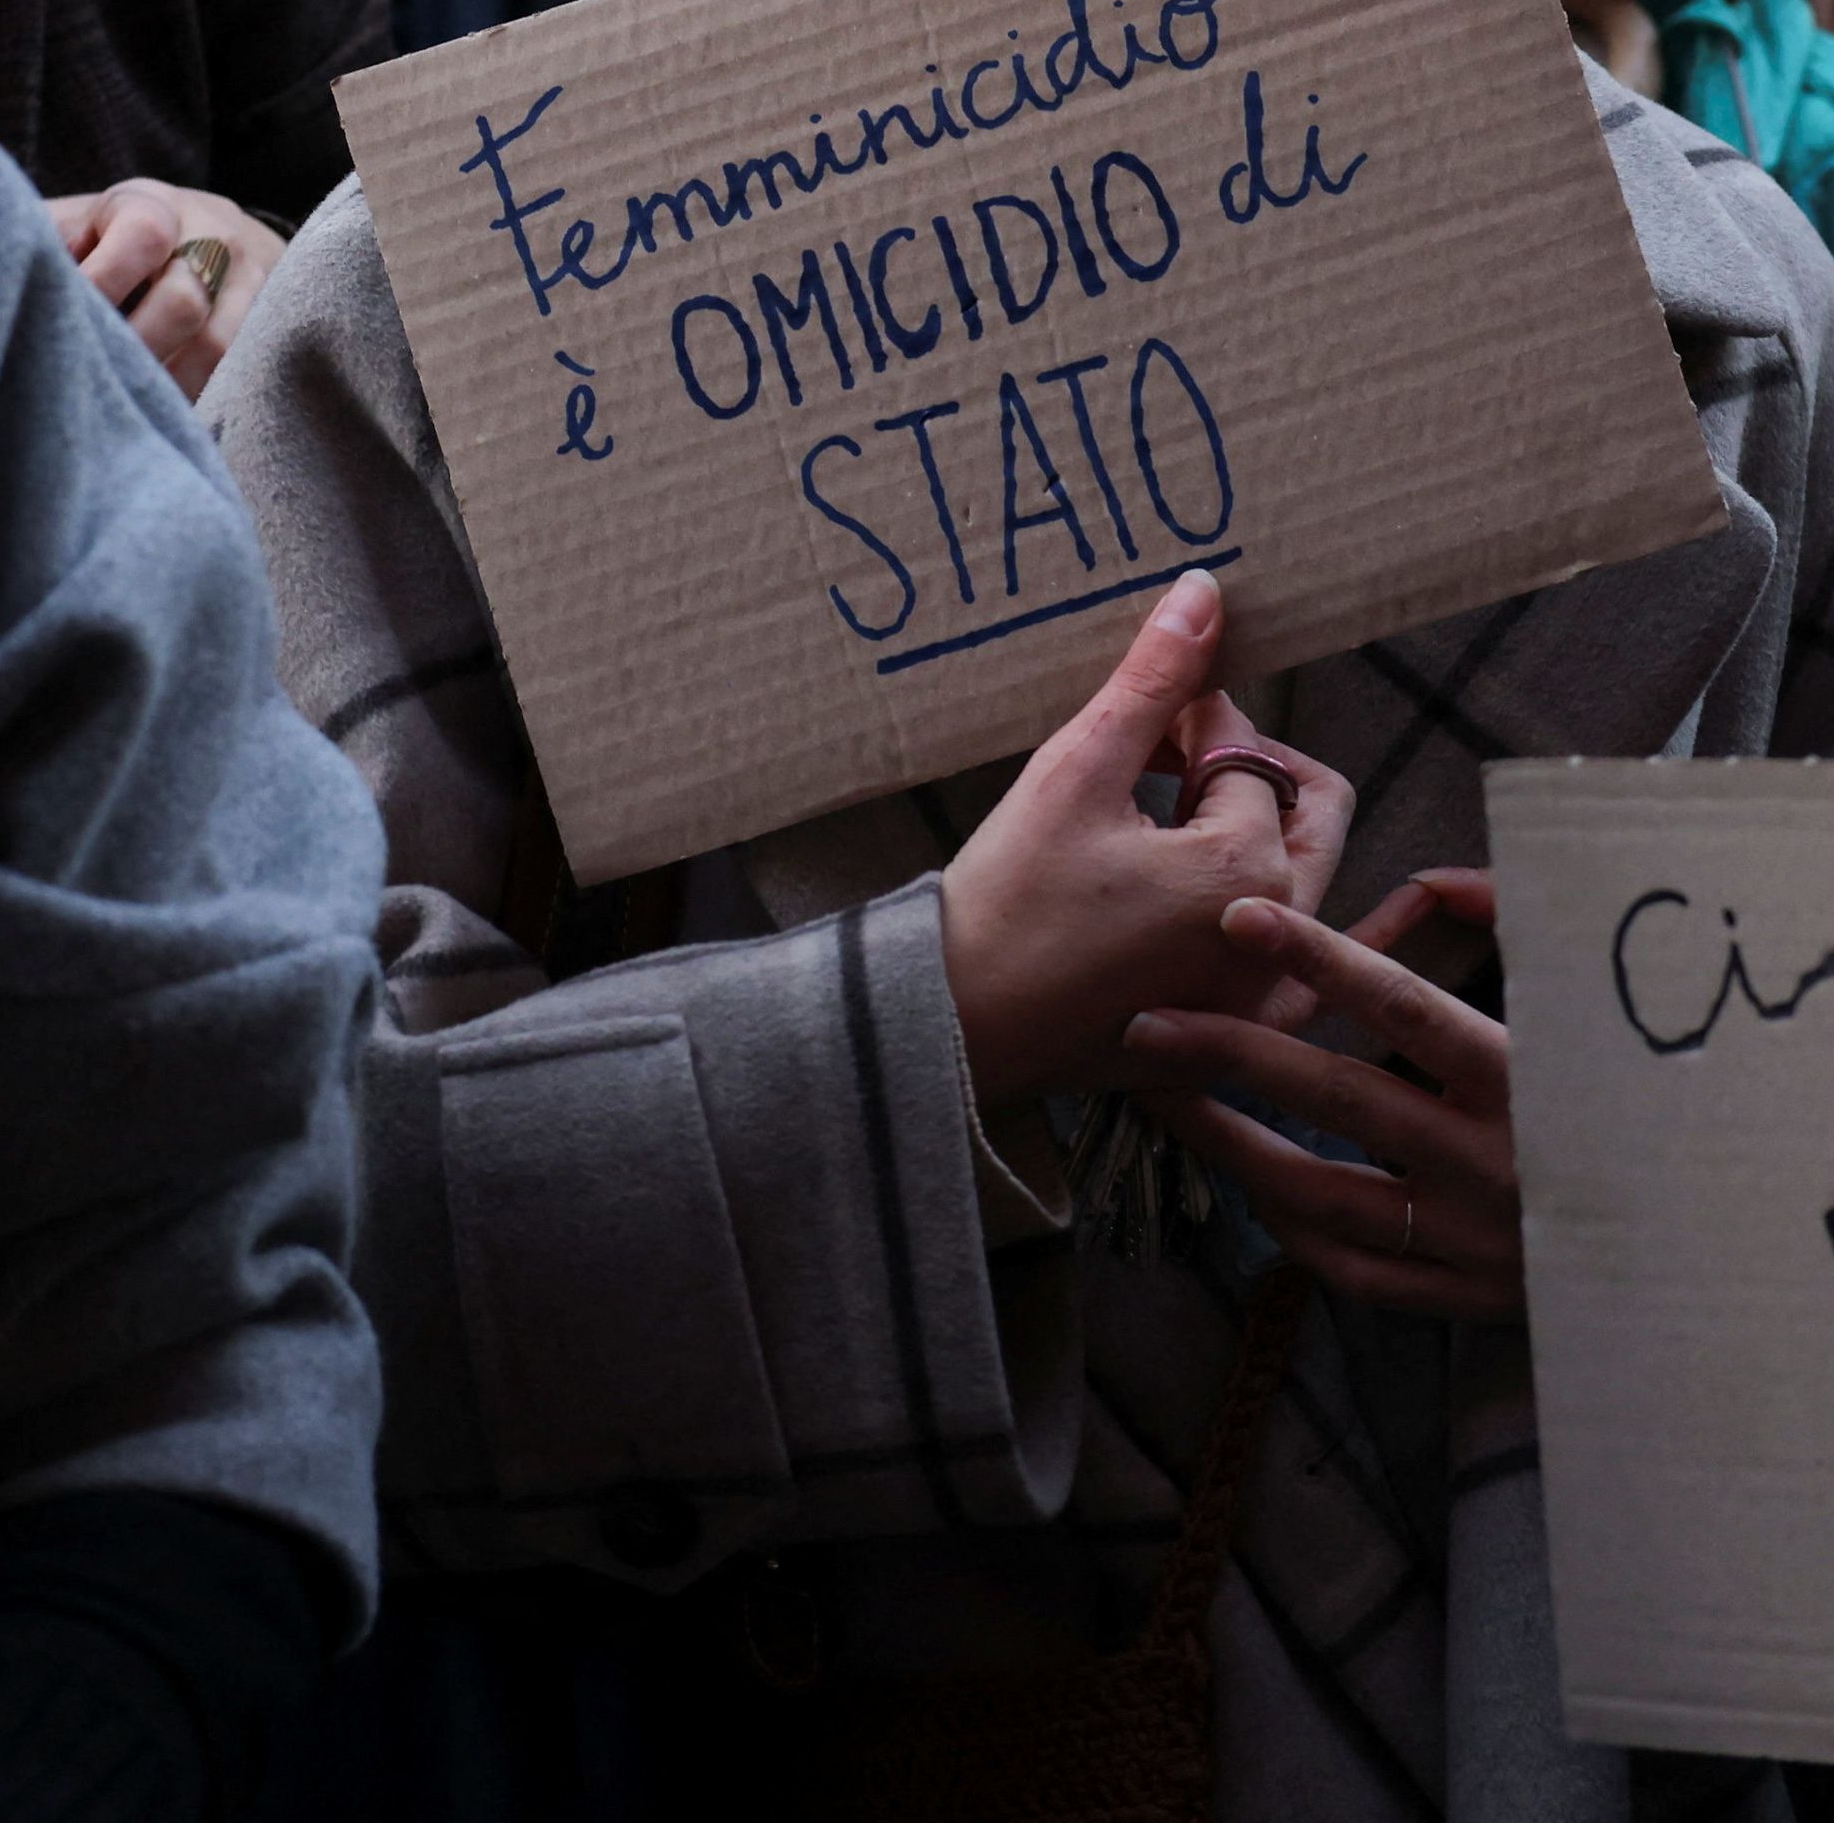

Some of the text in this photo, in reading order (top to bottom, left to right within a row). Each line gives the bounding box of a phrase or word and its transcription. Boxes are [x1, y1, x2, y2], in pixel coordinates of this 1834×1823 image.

[556, 73, 1367, 461] è OMICIDIO di
[800, 337, 1235, 641] STATO
